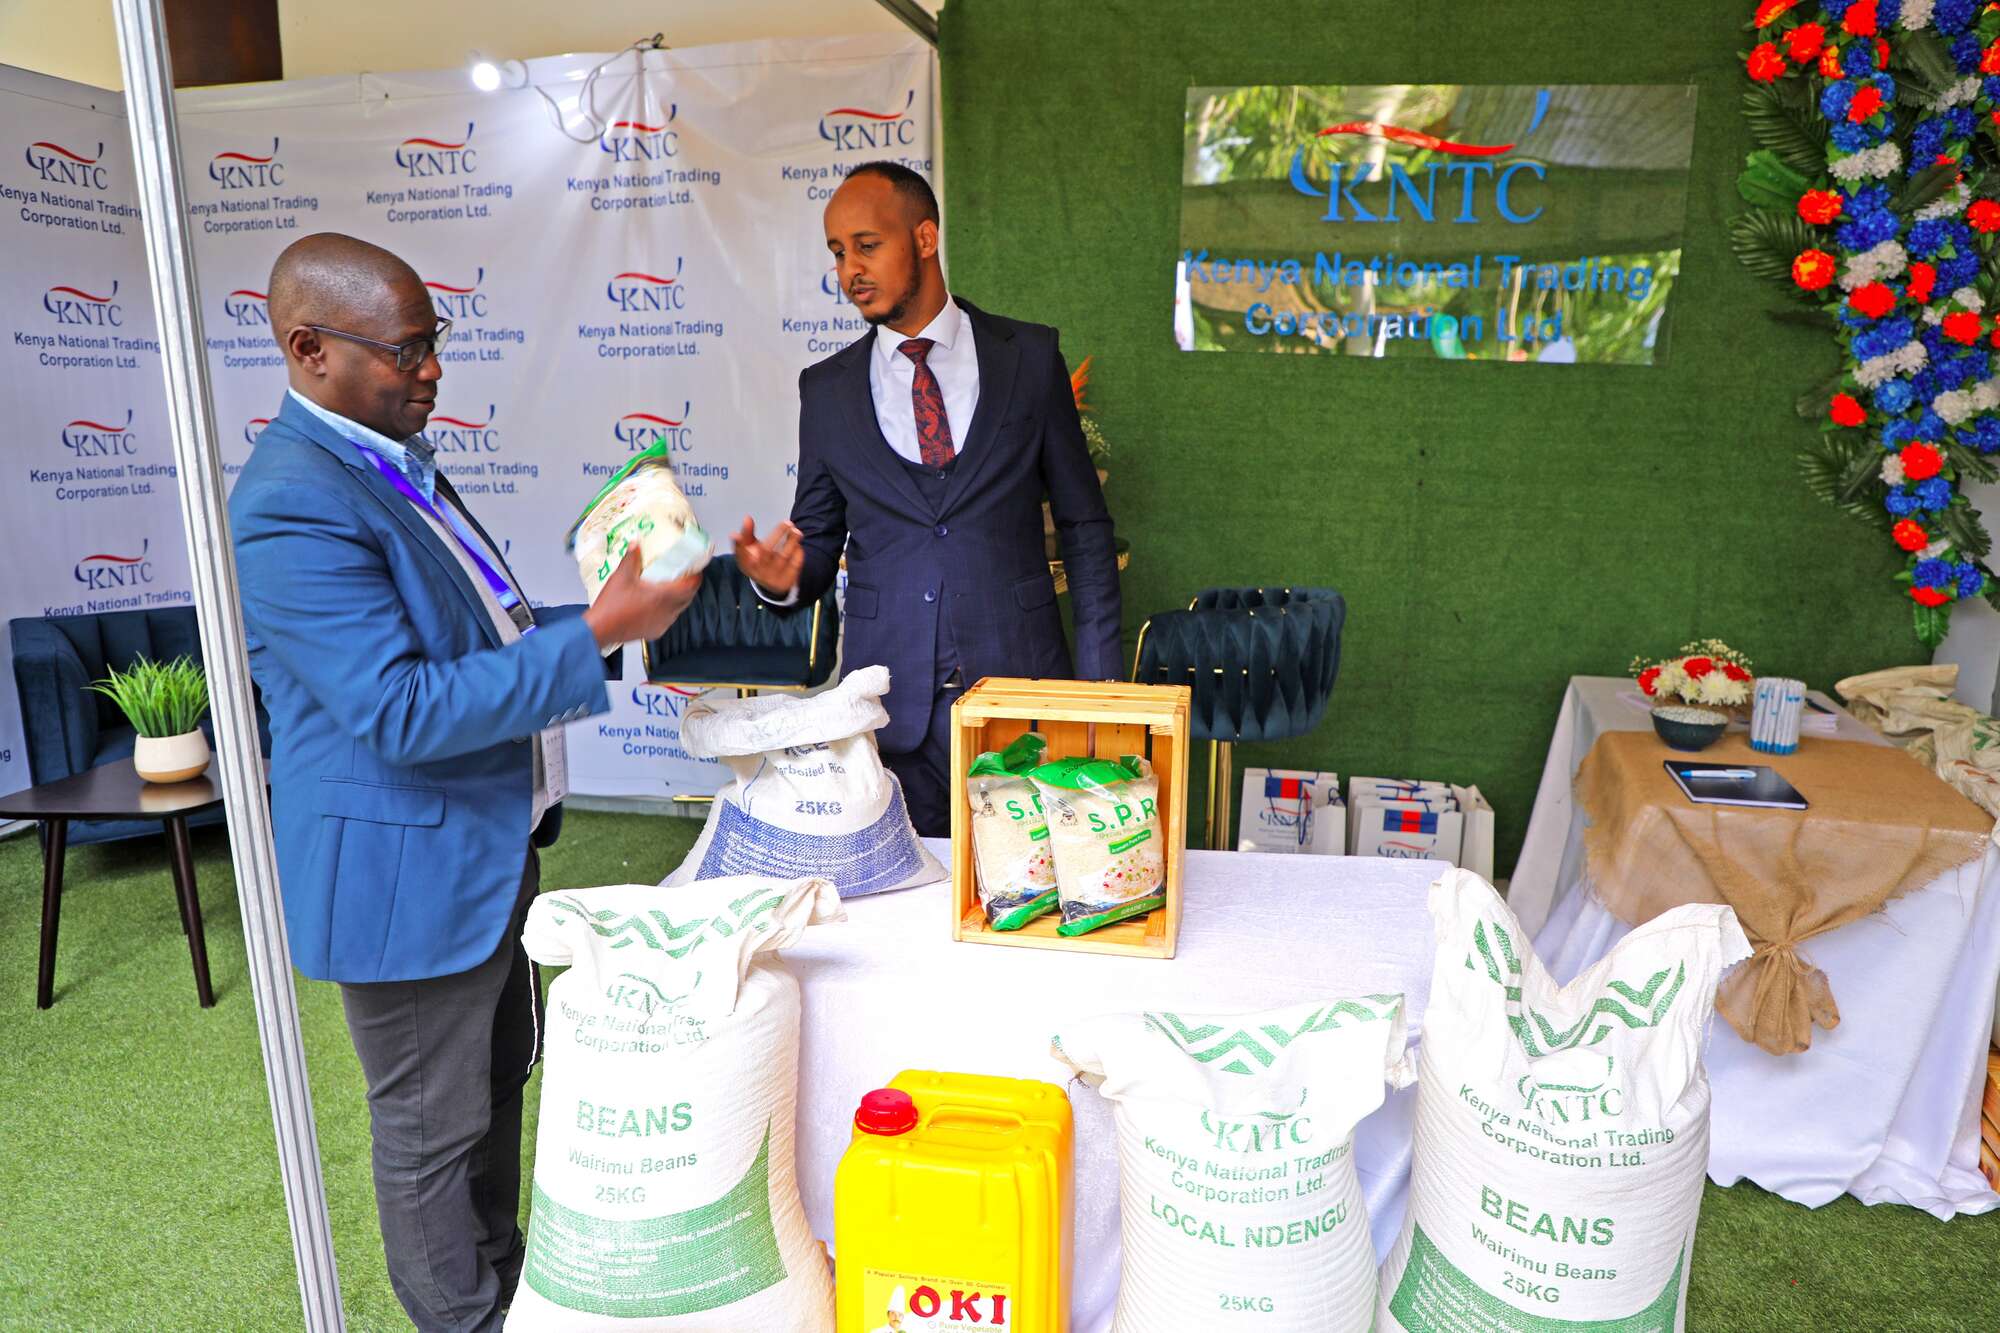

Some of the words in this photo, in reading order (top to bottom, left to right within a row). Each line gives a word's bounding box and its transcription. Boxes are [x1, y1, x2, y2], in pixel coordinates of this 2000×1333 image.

[601, 131, 678, 162] KNTC
[819, 118, 915, 151] KNTC
[26, 147, 109, 190] KNTC
[209, 160, 284, 189] KNTC
[396, 148, 477, 177] KNTC
[782, 165, 828, 182] Kenya
[567, 177, 610, 193] Kenya
[614, 173, 663, 188] National
[665, 168, 720, 185] Trading
[1289, 145, 1547, 224] KNTC
[41, 191, 94, 212] National
[221, 198, 269, 213] National
[274, 195, 318, 211] Trading
[366, 191, 404, 206] Kenya
[408, 185, 459, 201] National
[463, 182, 513, 198] Trading
[591, 195, 667, 212] Corporation
[669, 190, 694, 204] Ltd.
[20, 208, 98, 232] Corporation
[101, 220, 125, 235] Ltd.
[204, 217, 273, 234] Corporation
[276, 216, 299, 229] Ltd.
[387, 206, 462, 223] Corporation
[467, 204, 491, 218] Ltd.
[1183, 249, 1301, 294] Kenya
[1314, 251, 1482, 288] National
[1494, 255, 1652, 300] Trading
[44, 291, 122, 327] KNTC
[433, 294, 487, 318] NTC
[607, 282, 685, 312] KNTC
[225, 298, 268, 326] KN
[1245, 302, 1483, 344] Corporation
[476, 328, 524, 344] Trading
[578, 325, 615, 340] Kenya
[620, 323, 672, 337] National
[675, 321, 723, 336] Trading
[782, 318, 828, 335] Kenya
[14, 332, 55, 349] Kenya
[58, 334, 109, 349] National
[238, 337, 278, 348] Nation
[598, 343, 676, 360] Corporation
[677, 342, 699, 355] Ltd.
[40, 352, 113, 369] Corporation
[117, 356, 140, 368] Ltd.
[439, 349, 476, 362] ration
[480, 348, 504, 361] Ltd.
[62, 428, 137, 457] KNTC
[421, 430, 500, 452] KNTC
[30, 470, 73, 485] Kenya
[76, 465, 124, 480] National
[127, 463, 177, 478] Trading
[488, 463, 538, 478] Trading
[682, 463, 728, 480] Trading
[56, 484, 128, 501] Corporation
[131, 482, 155, 495] Ltd.
[493, 481, 518, 494] Ltd.
[685, 484, 707, 496] Ltd.
[74, 562, 153, 590] KNTC
[87, 596, 142, 612] National
[144, 590, 191, 604] Trading
[598, 725, 641, 739] Kenya
[795, 800, 842, 815] 25KG
[560, 1000, 597, 1026] Kenya
[603, 1015, 671, 1036] National
[1518, 1075, 1624, 1125] KNTC
[577, 1099, 693, 1138] BEANS
[1459, 1083, 1510, 1126] Kenya
[1517, 1119, 1597, 1149] National
[1604, 1127, 1675, 1146] Trading
[1201, 1109, 1312, 1153] KNTC
[1481, 1122, 1602, 1168] Corporation
[1610, 1152, 1646, 1168] Ltd.
[569, 1147, 633, 1175] Wairimu
[641, 1152, 697, 1174] Beans
[1145, 1136, 1198, 1171] Kenya
[1205, 1162, 1288, 1182] National
[595, 1184, 646, 1204] 25KG
[1171, 1171, 1289, 1204] Corporation
[1296, 1174, 1327, 1198] Ltd.
[1151, 1195, 1235, 1247] LOCAL
[1245, 1199, 1347, 1249] NDENGU
[1480, 1185, 1615, 1246] BEANS
[1471, 1222, 1547, 1276] Wairimu
[1555, 1262, 1617, 1281] Beans
[1502, 1271, 1561, 1302] 25KG
[909, 1285, 1006, 1325] OKI
[1219, 1294, 1275, 1313] 25KG
